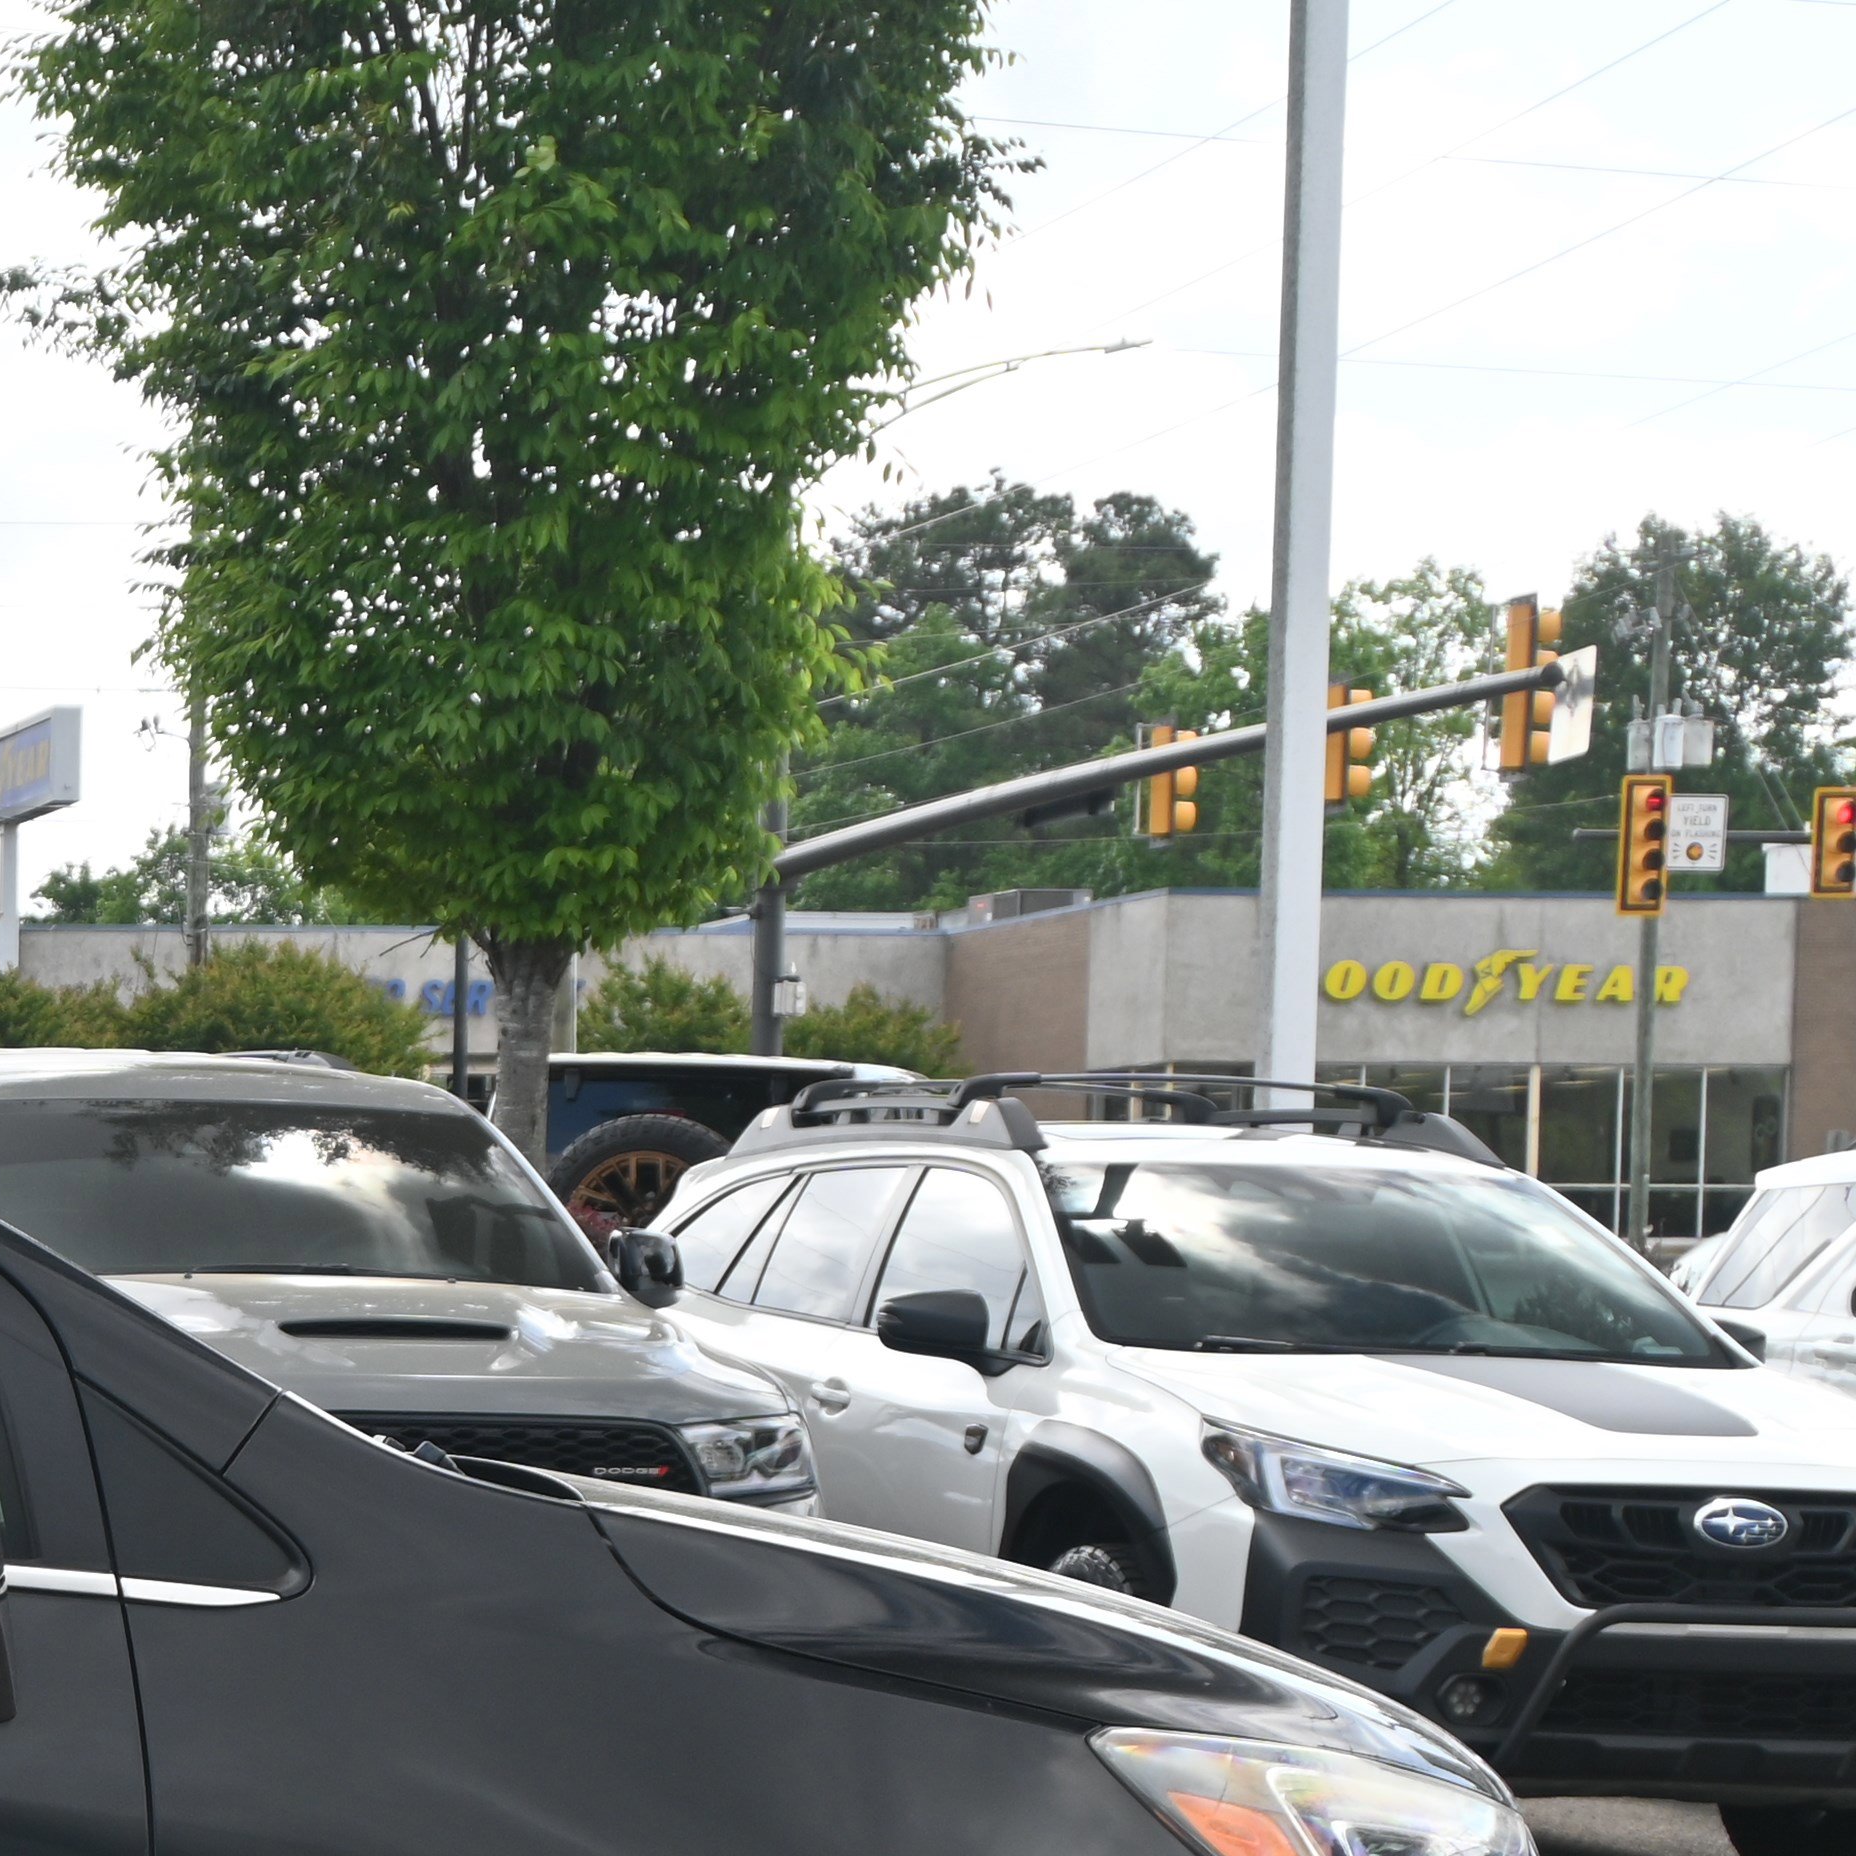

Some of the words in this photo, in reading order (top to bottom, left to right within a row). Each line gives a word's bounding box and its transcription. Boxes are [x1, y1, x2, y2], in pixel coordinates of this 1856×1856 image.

[1684, 816, 1711, 826] YIELD
[1325, 959, 1689, 1002] OODYEAR
[593, 1466, 660, 1475] DODGE
